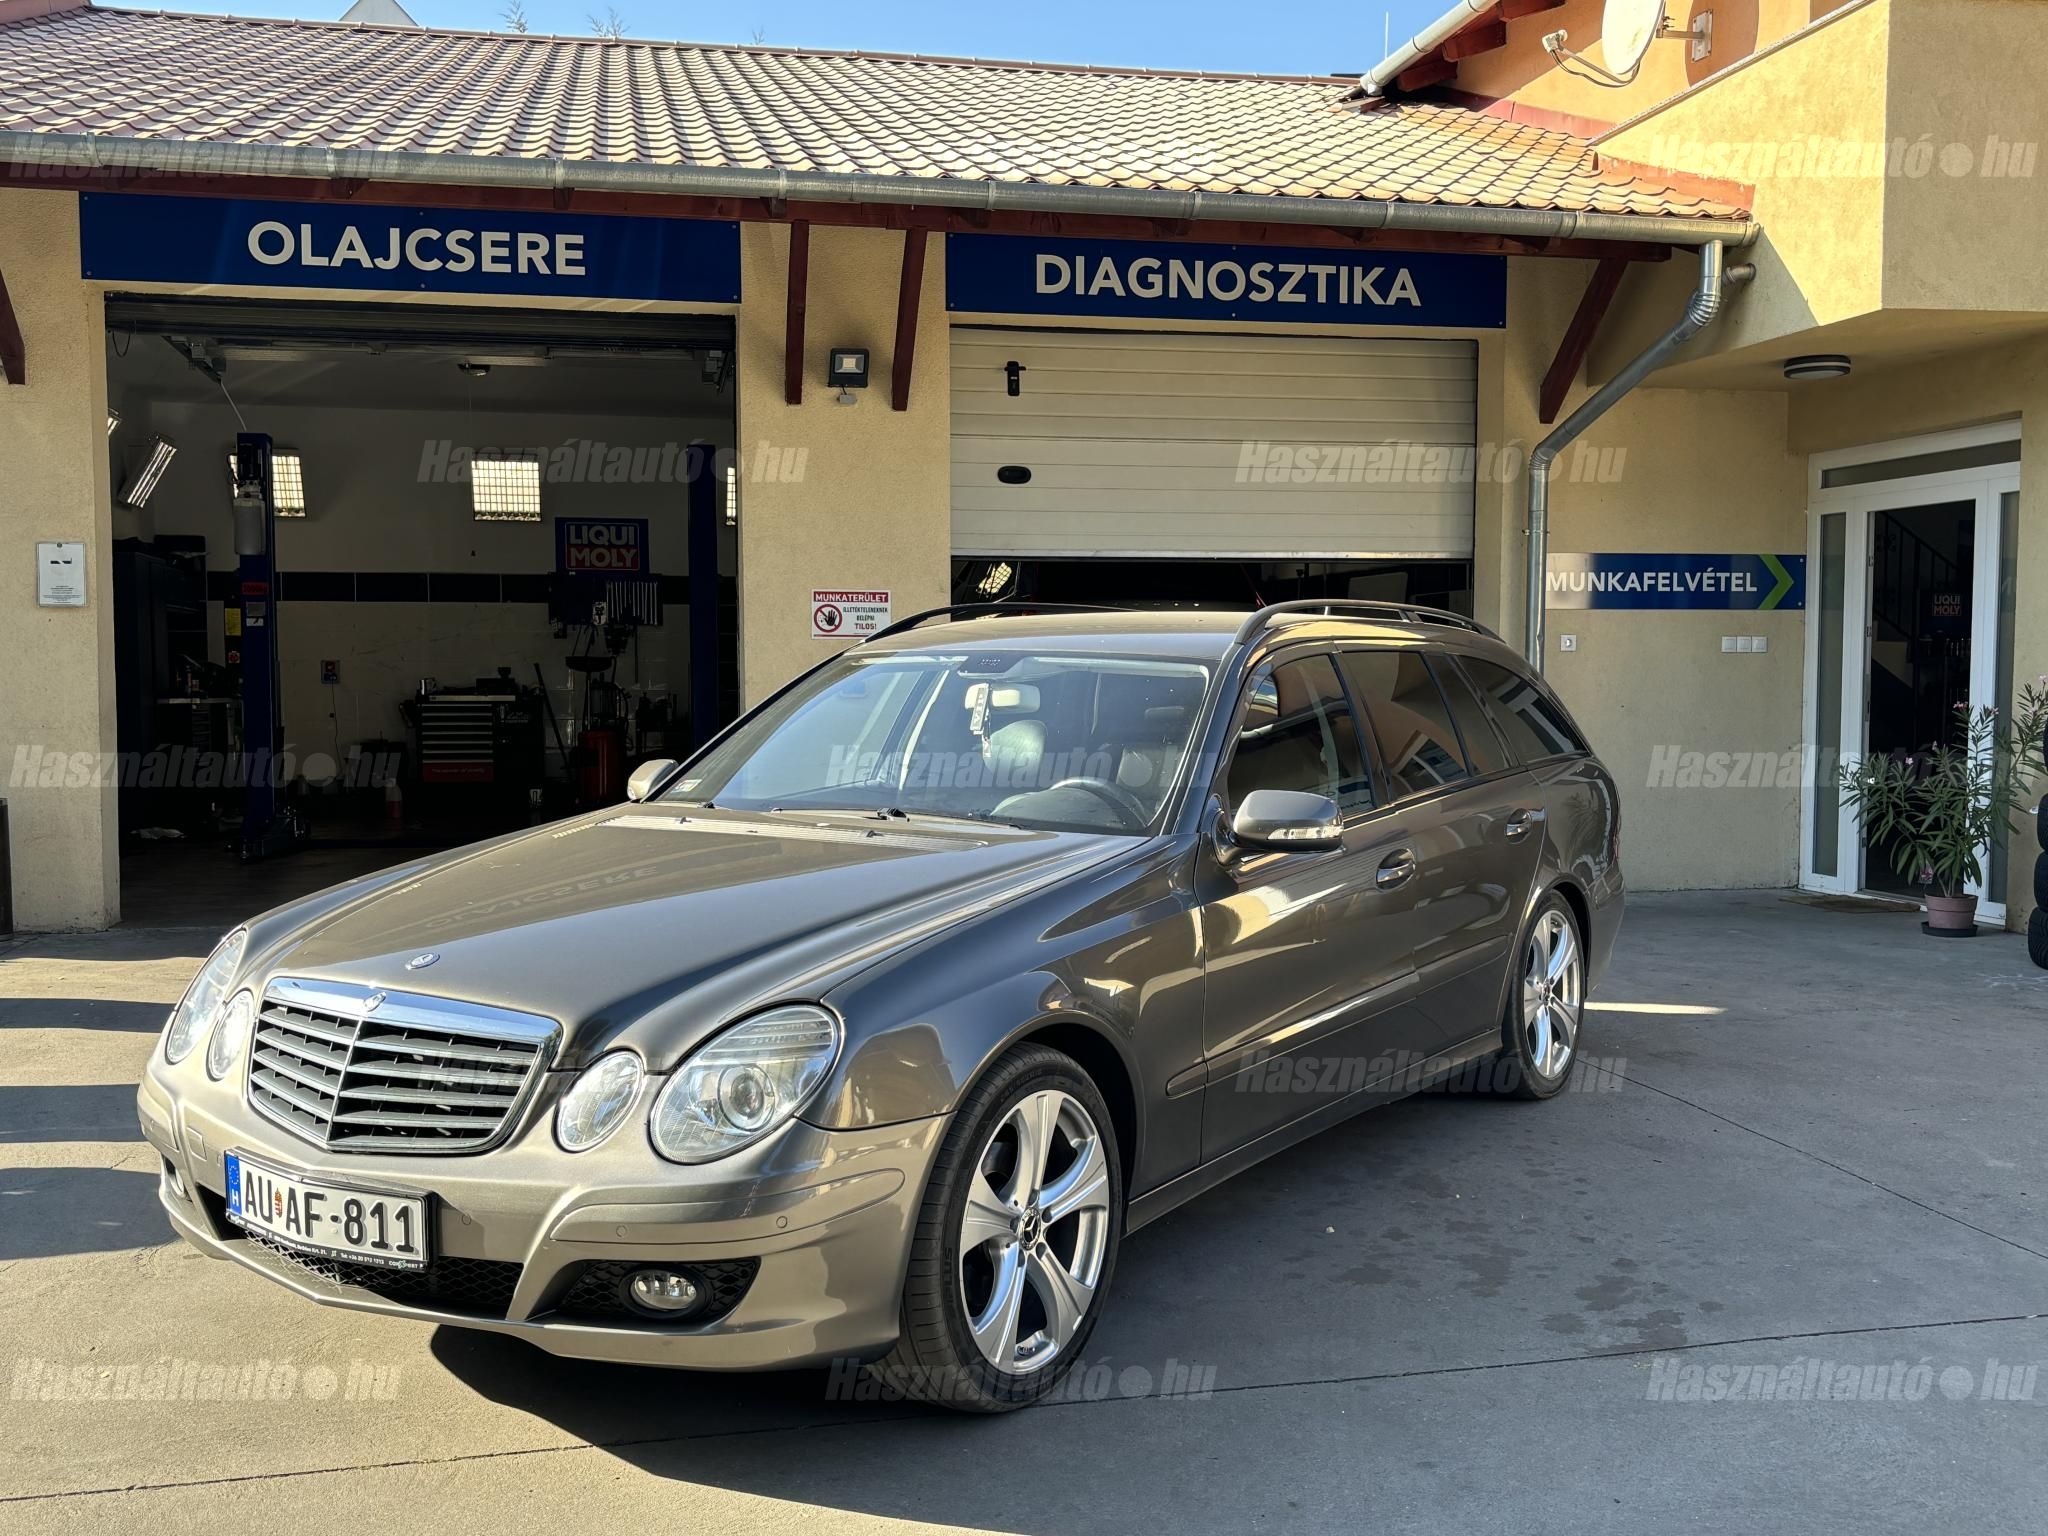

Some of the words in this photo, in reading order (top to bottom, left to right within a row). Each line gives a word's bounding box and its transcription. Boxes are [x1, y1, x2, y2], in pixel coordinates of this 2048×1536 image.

[248, 221, 586, 276] OLAJCSERE
[1035, 253, 1422, 308] DIAGNOSZTIKA
[569, 525, 635, 546] LIQUI
[570, 547, 637, 568] MOLY
[1546, 567, 1758, 592] MUNKAFELVÉTEL
[815, 592, 887, 602] MUNKATERÜLET
[1934, 594, 1961, 605] LIQUI
[1933, 605, 1961, 615] MOLY
[231, 1189, 240, 1207] H
